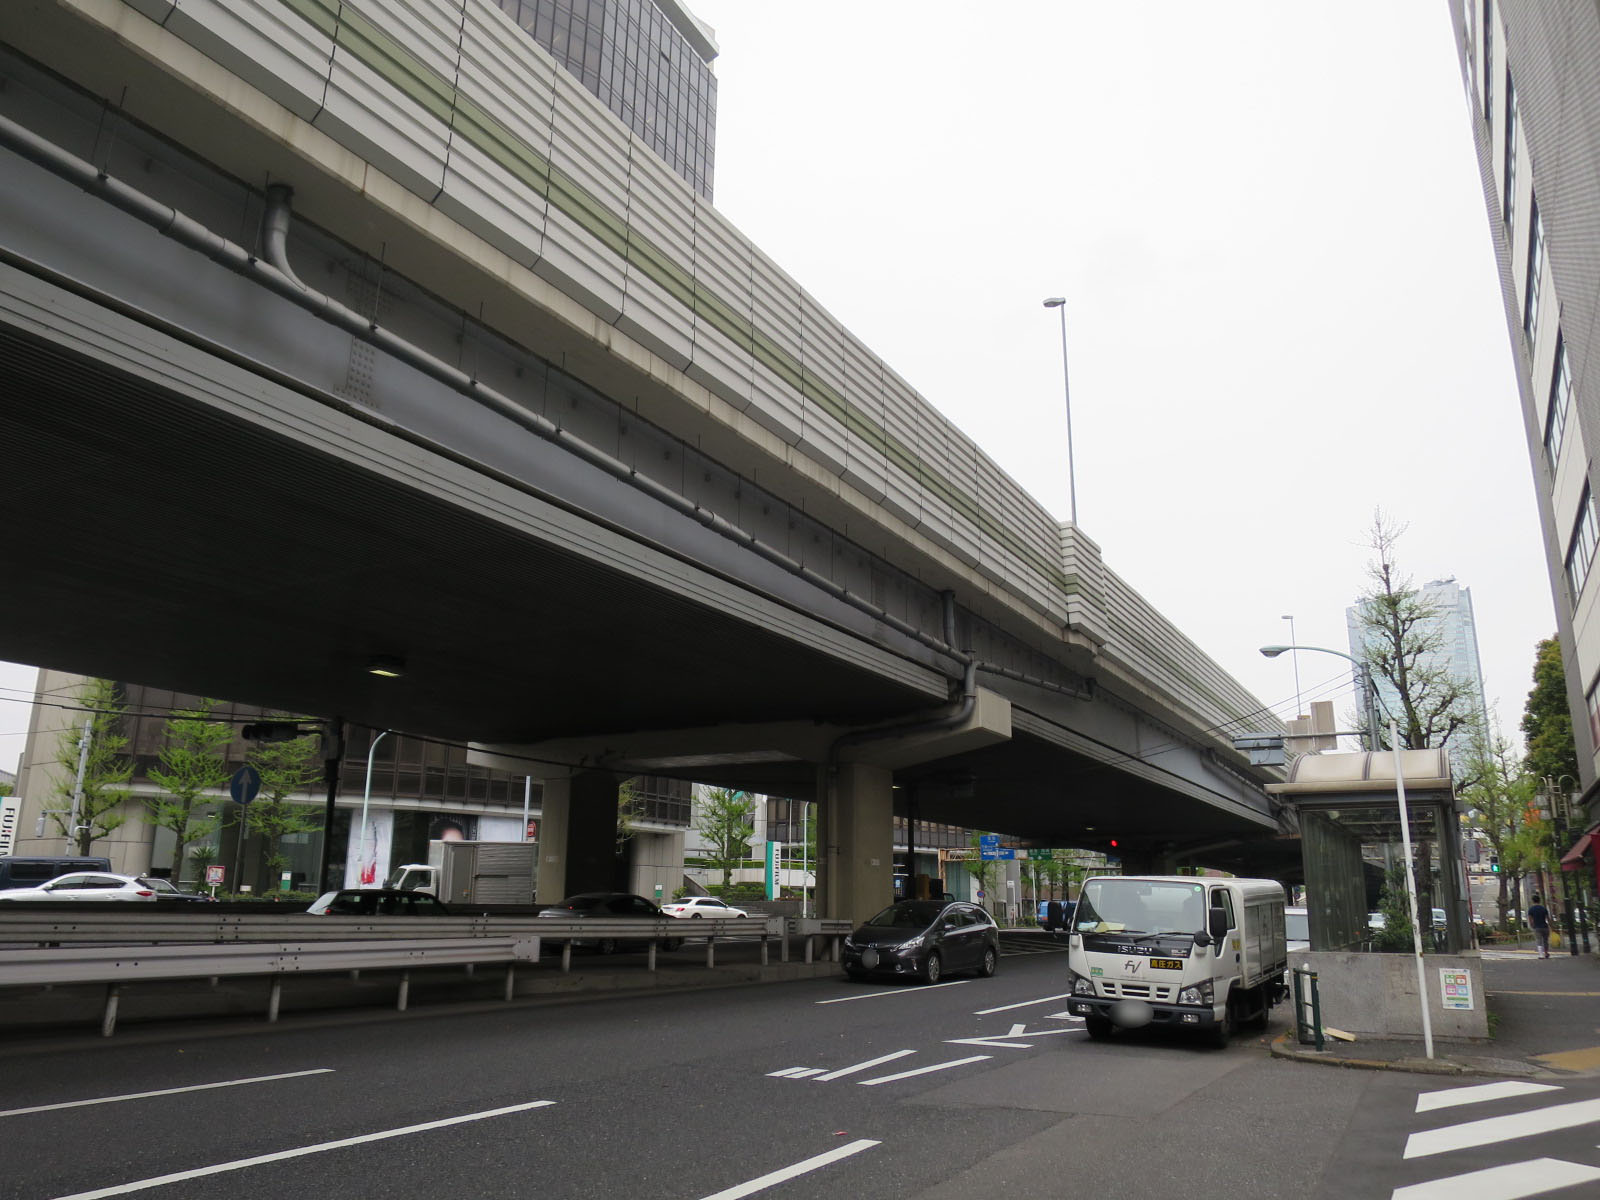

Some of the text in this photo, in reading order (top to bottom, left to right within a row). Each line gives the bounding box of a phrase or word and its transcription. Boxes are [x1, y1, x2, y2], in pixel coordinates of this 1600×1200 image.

[1118, 945, 1153, 954] ISUZU
[1151, 960, 1182, 969] 高圧ガス
